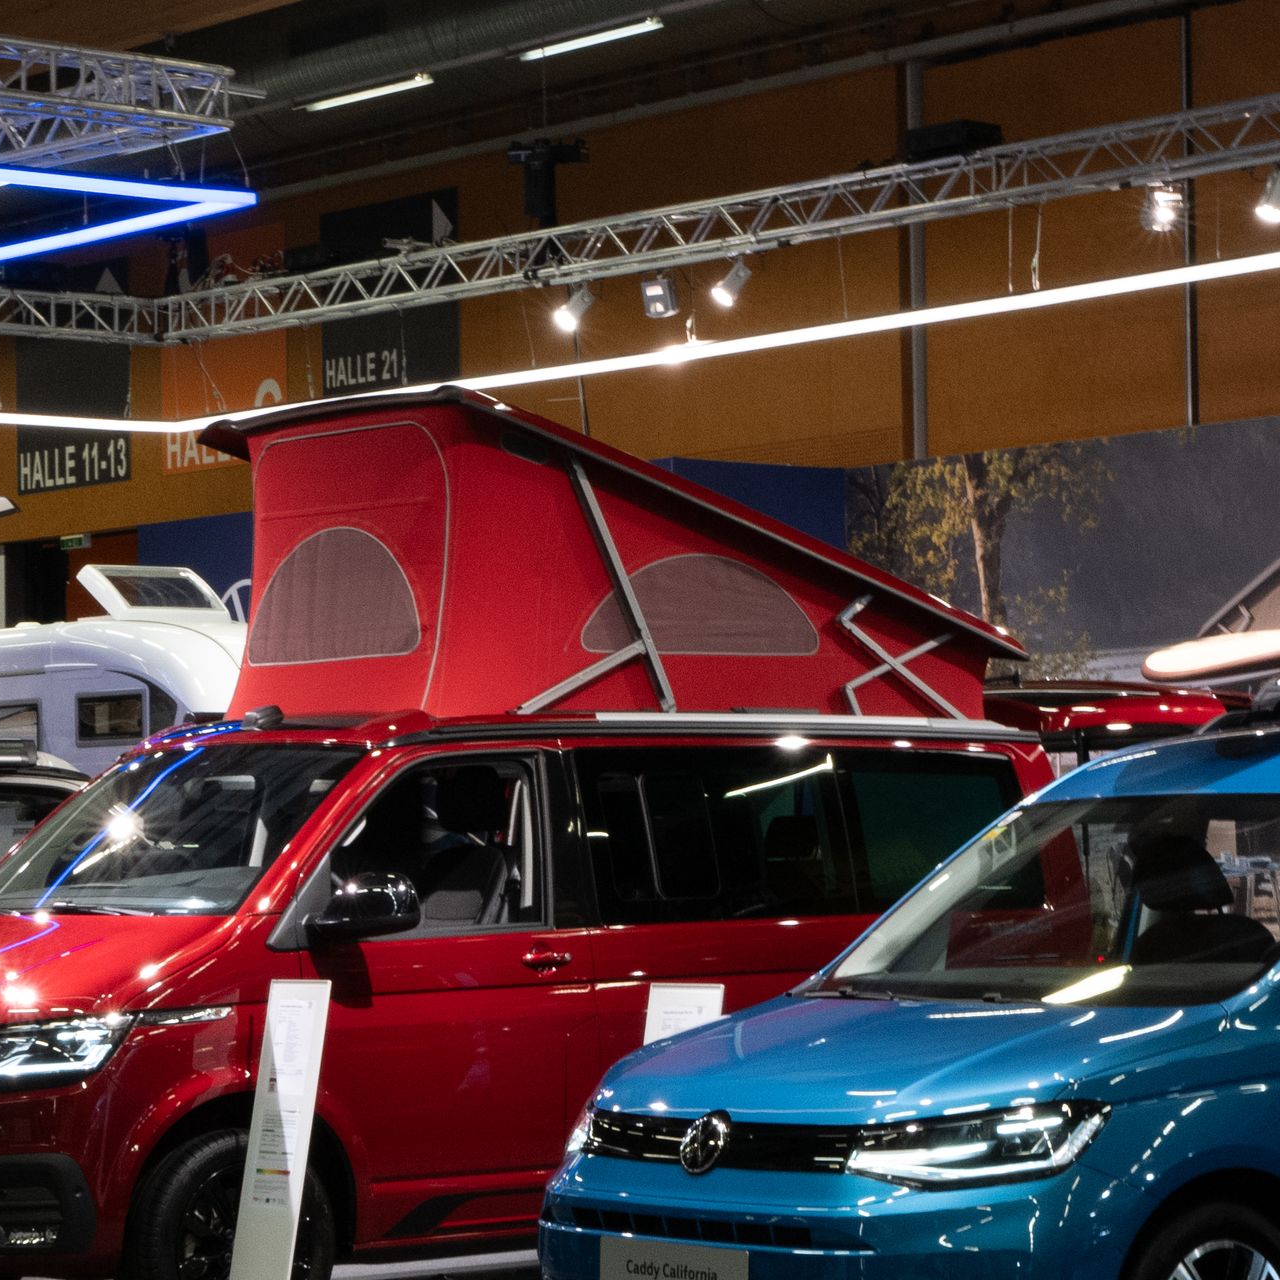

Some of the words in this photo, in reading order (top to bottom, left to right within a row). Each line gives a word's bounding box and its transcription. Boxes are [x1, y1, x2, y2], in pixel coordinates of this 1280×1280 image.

[325, 352, 376, 389] HALLE
[381, 348, 398, 380] 21
[20, 446, 76, 491] HALLE
[82, 438, 126, 482] 11-13
[626, 1260, 658, 1279] Caddy
